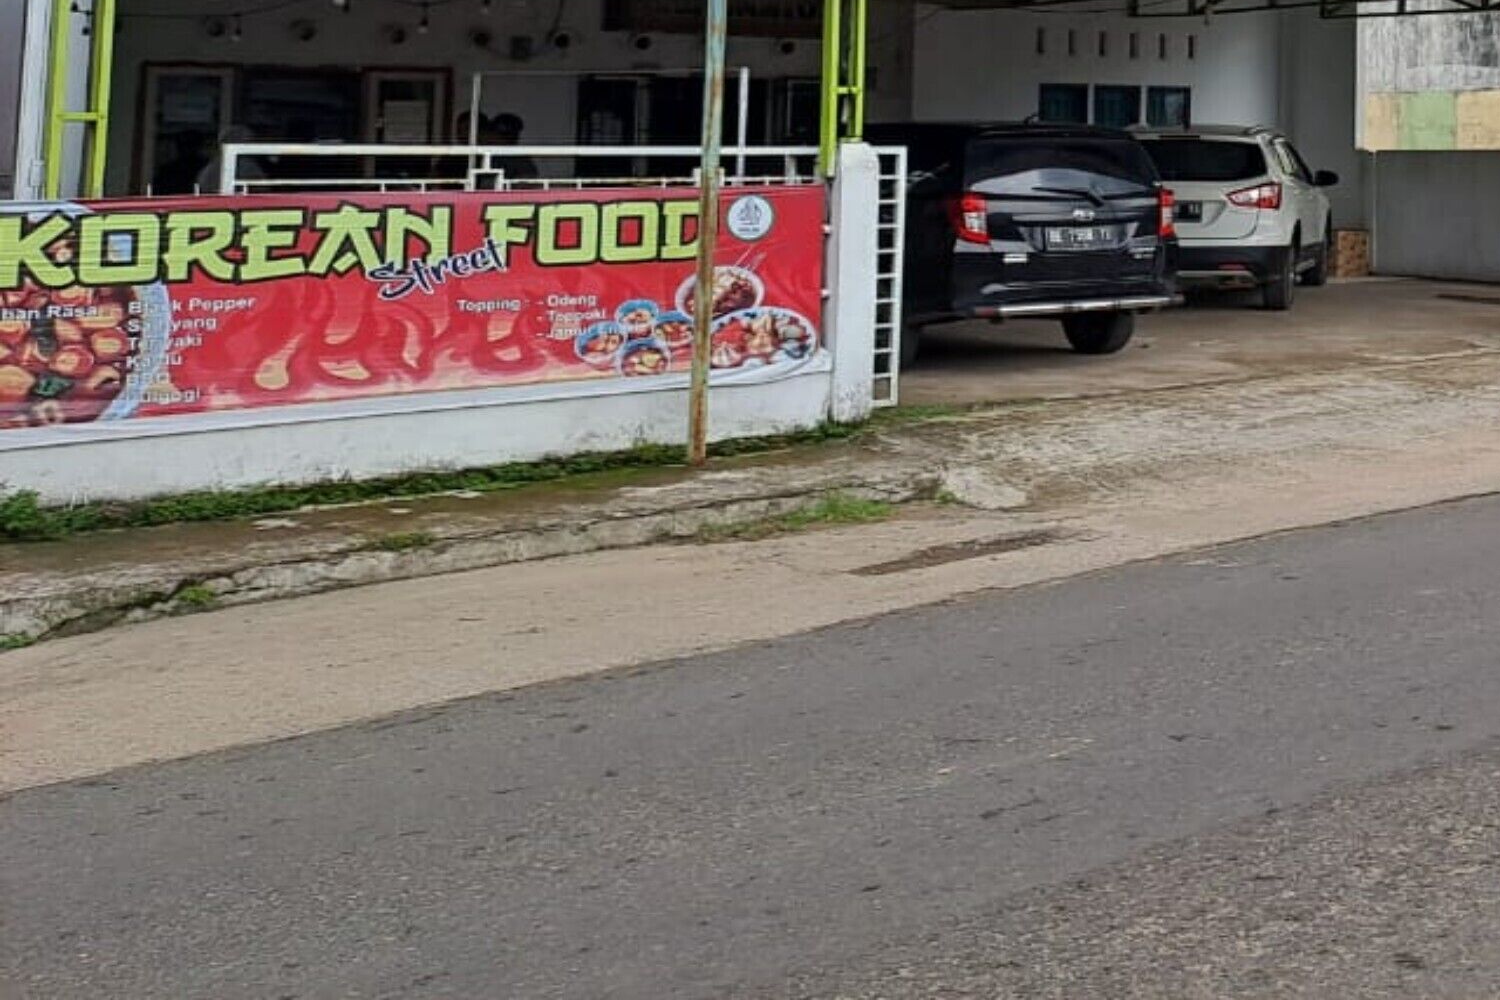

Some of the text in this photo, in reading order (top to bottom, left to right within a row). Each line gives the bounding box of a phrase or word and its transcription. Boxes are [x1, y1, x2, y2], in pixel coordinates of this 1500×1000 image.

[0, 201, 700, 288] KOREAN FOOD
[368, 237, 507, 299] Street
[47, 304, 97, 319] Rasa
[188, 297, 257, 313] Pepper
[457, 294, 598, 313] Topping Odeng
